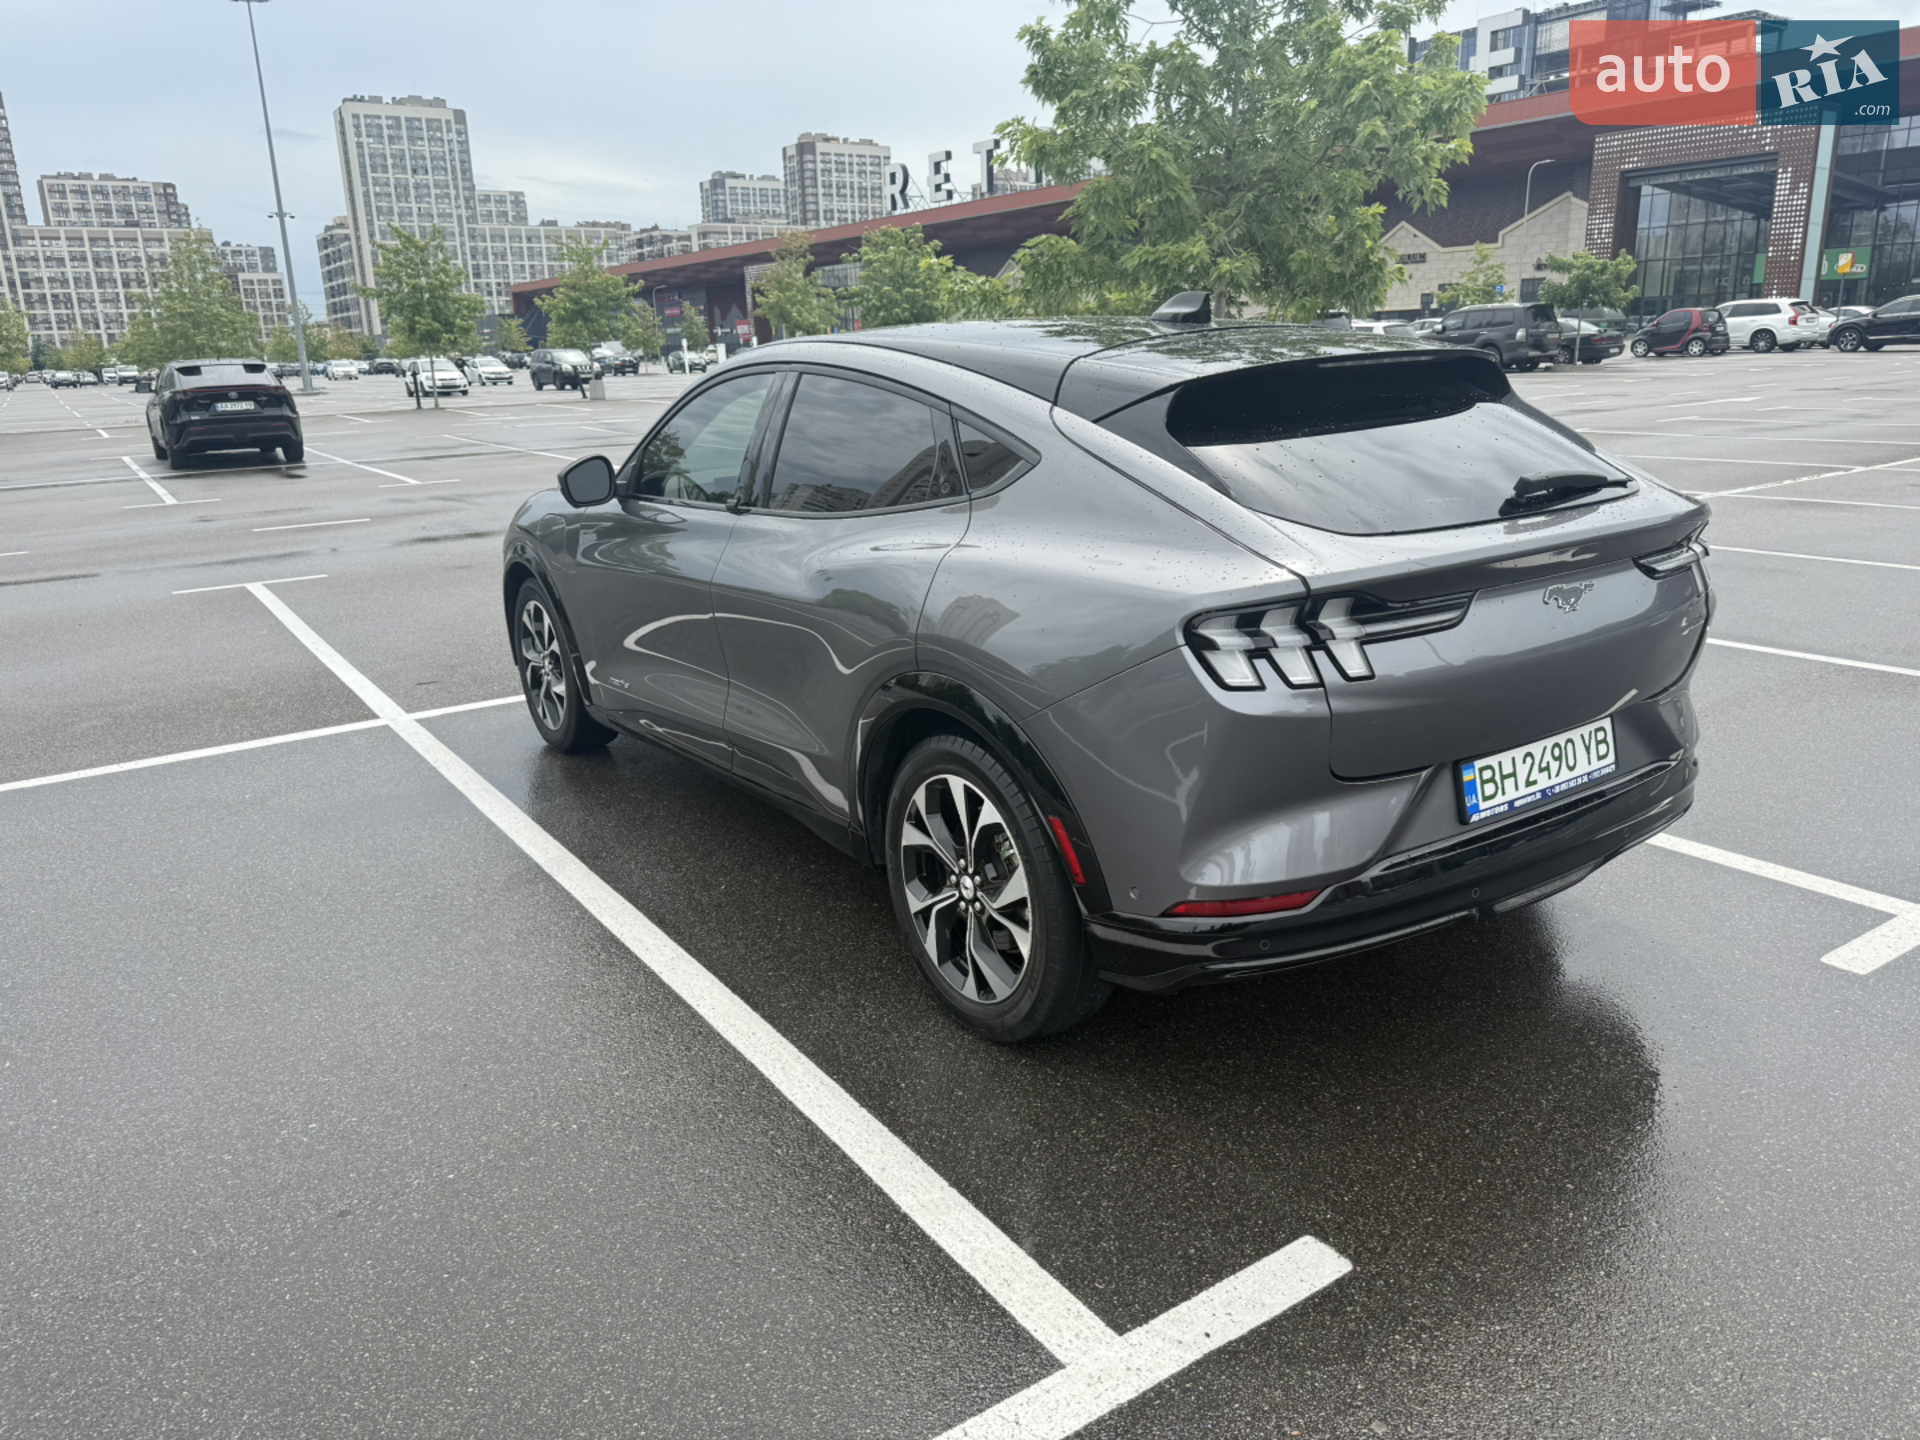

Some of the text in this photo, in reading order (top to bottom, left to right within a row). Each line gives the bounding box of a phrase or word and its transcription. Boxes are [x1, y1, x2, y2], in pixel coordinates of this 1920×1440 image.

[1478, 757, 1519, 803] BH
[1522, 738, 1577, 788] 2490
[1580, 726, 1610, 766] YB
[1465, 793, 1478, 806] UA
